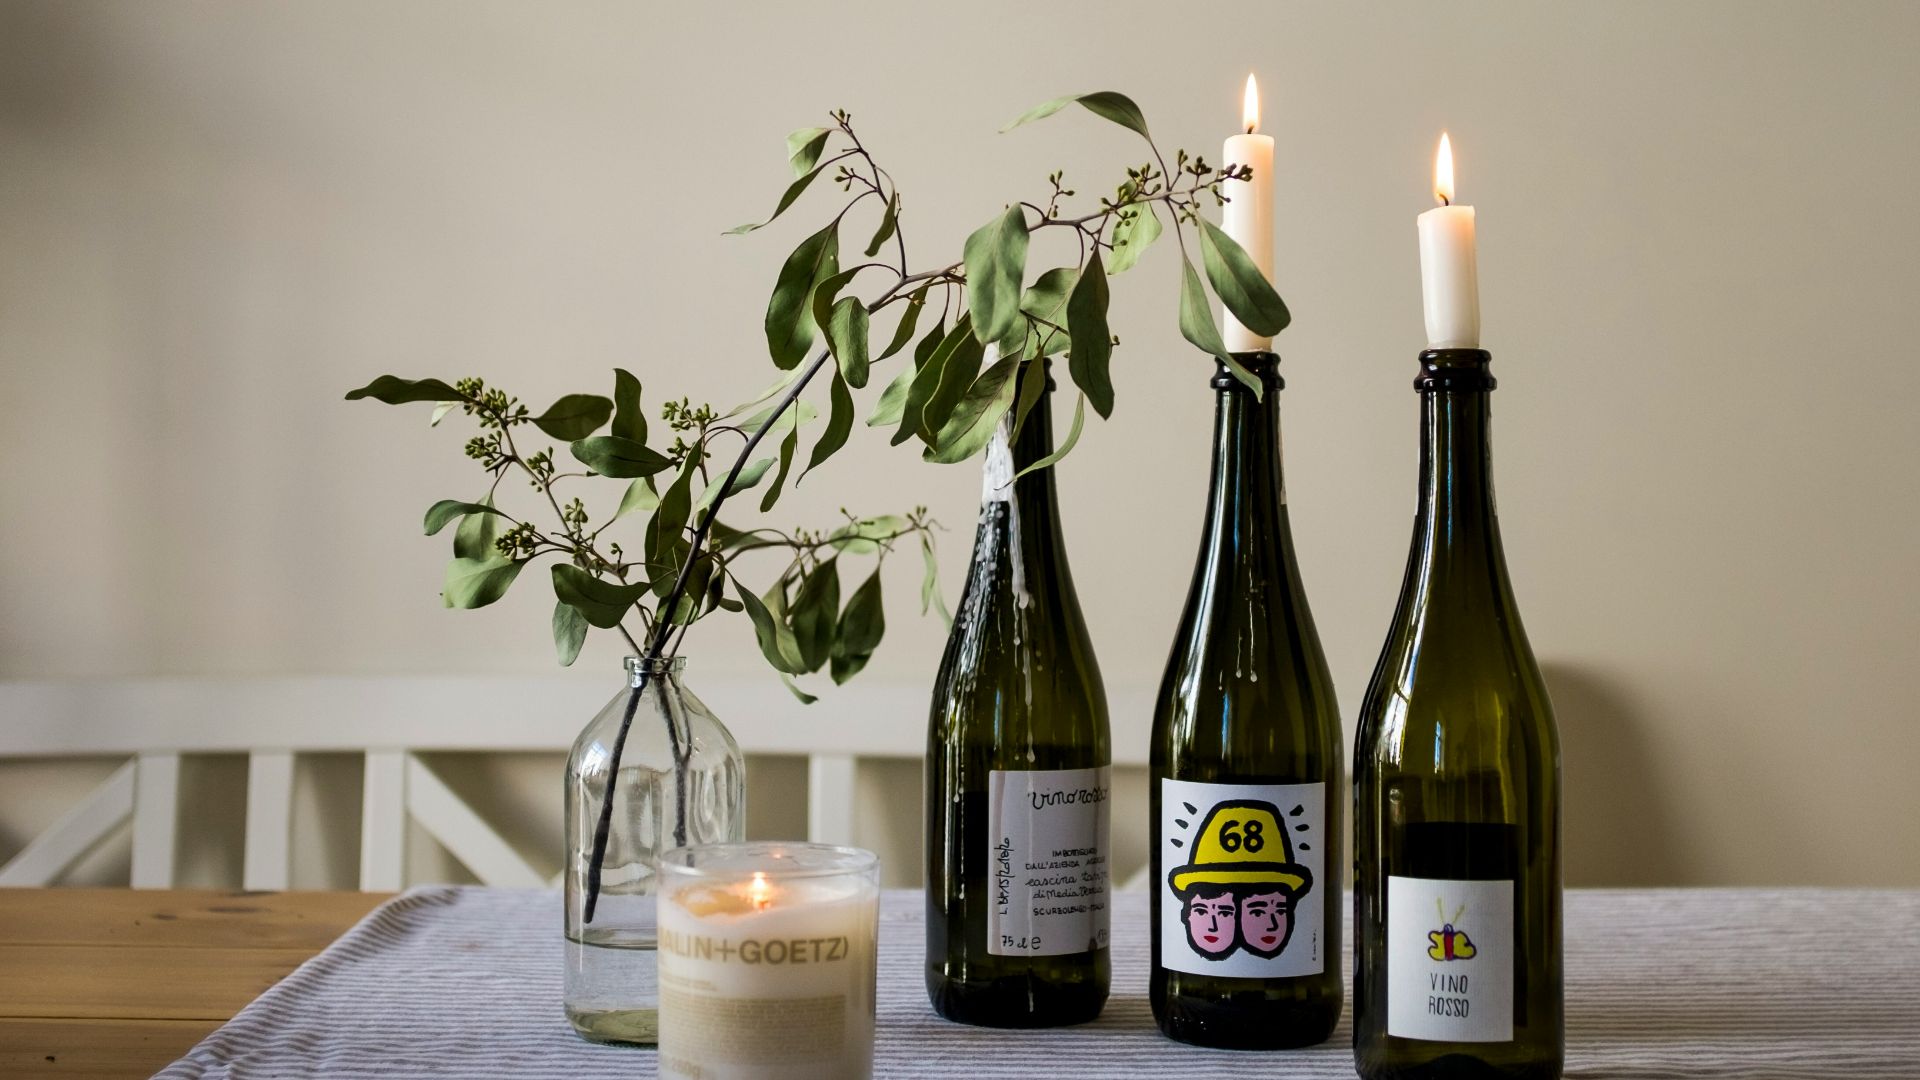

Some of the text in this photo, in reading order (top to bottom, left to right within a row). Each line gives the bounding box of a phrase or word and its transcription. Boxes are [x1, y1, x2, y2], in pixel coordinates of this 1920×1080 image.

[1028, 786, 1078, 810] vino
[1219, 820, 1264, 853] 68
[659, 925, 849, 965] ALIN+GOETZ)
[1001, 936, 1014, 947] 75
[1430, 973, 1468, 994] VINO
[1428, 996, 1469, 1018] ROSSO
